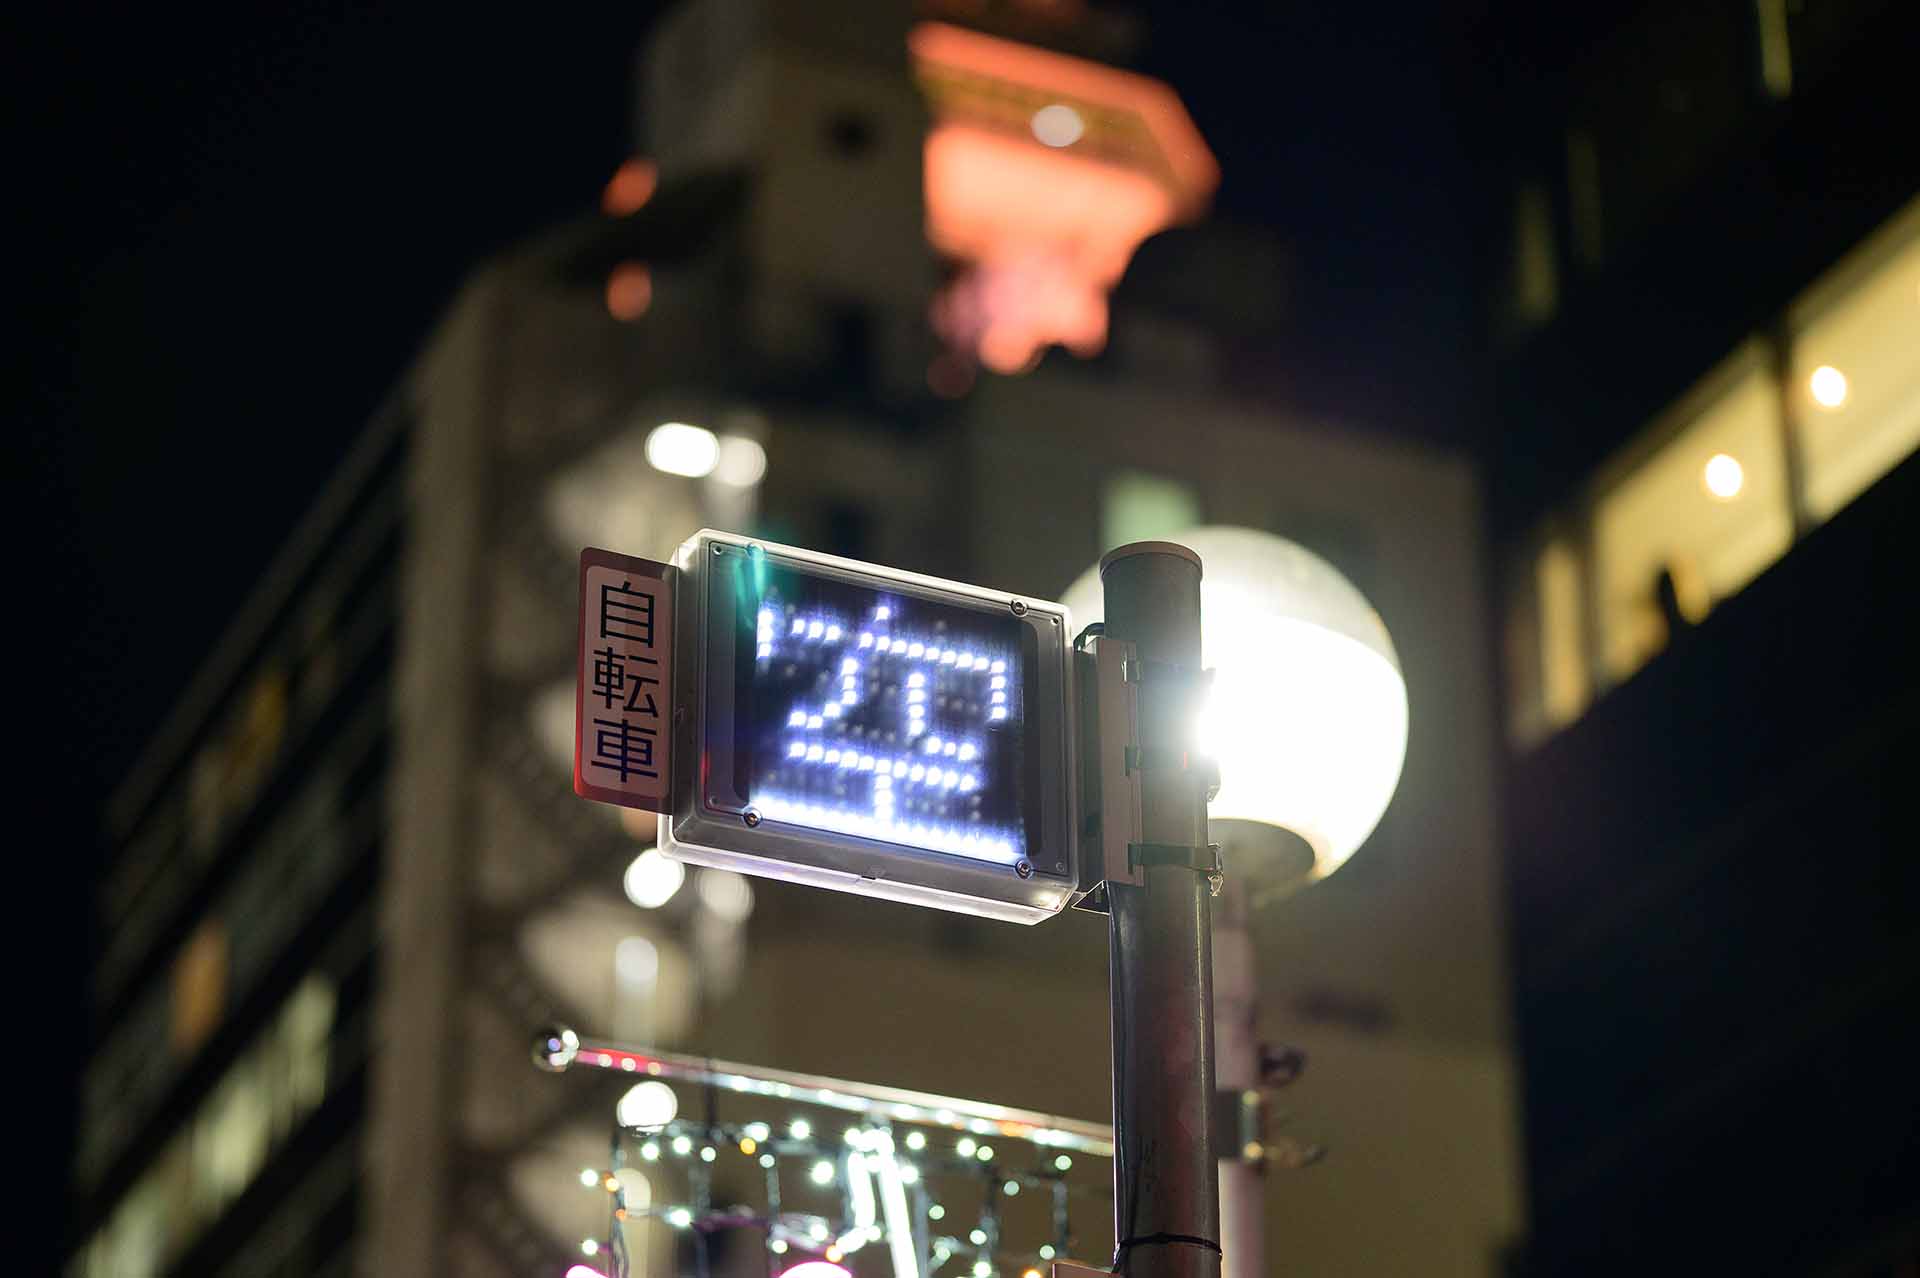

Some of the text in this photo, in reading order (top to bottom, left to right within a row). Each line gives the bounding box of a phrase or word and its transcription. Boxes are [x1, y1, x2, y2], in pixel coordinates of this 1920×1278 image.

[591, 581, 660, 783] 自転車
[751, 602, 1024, 861] 空
